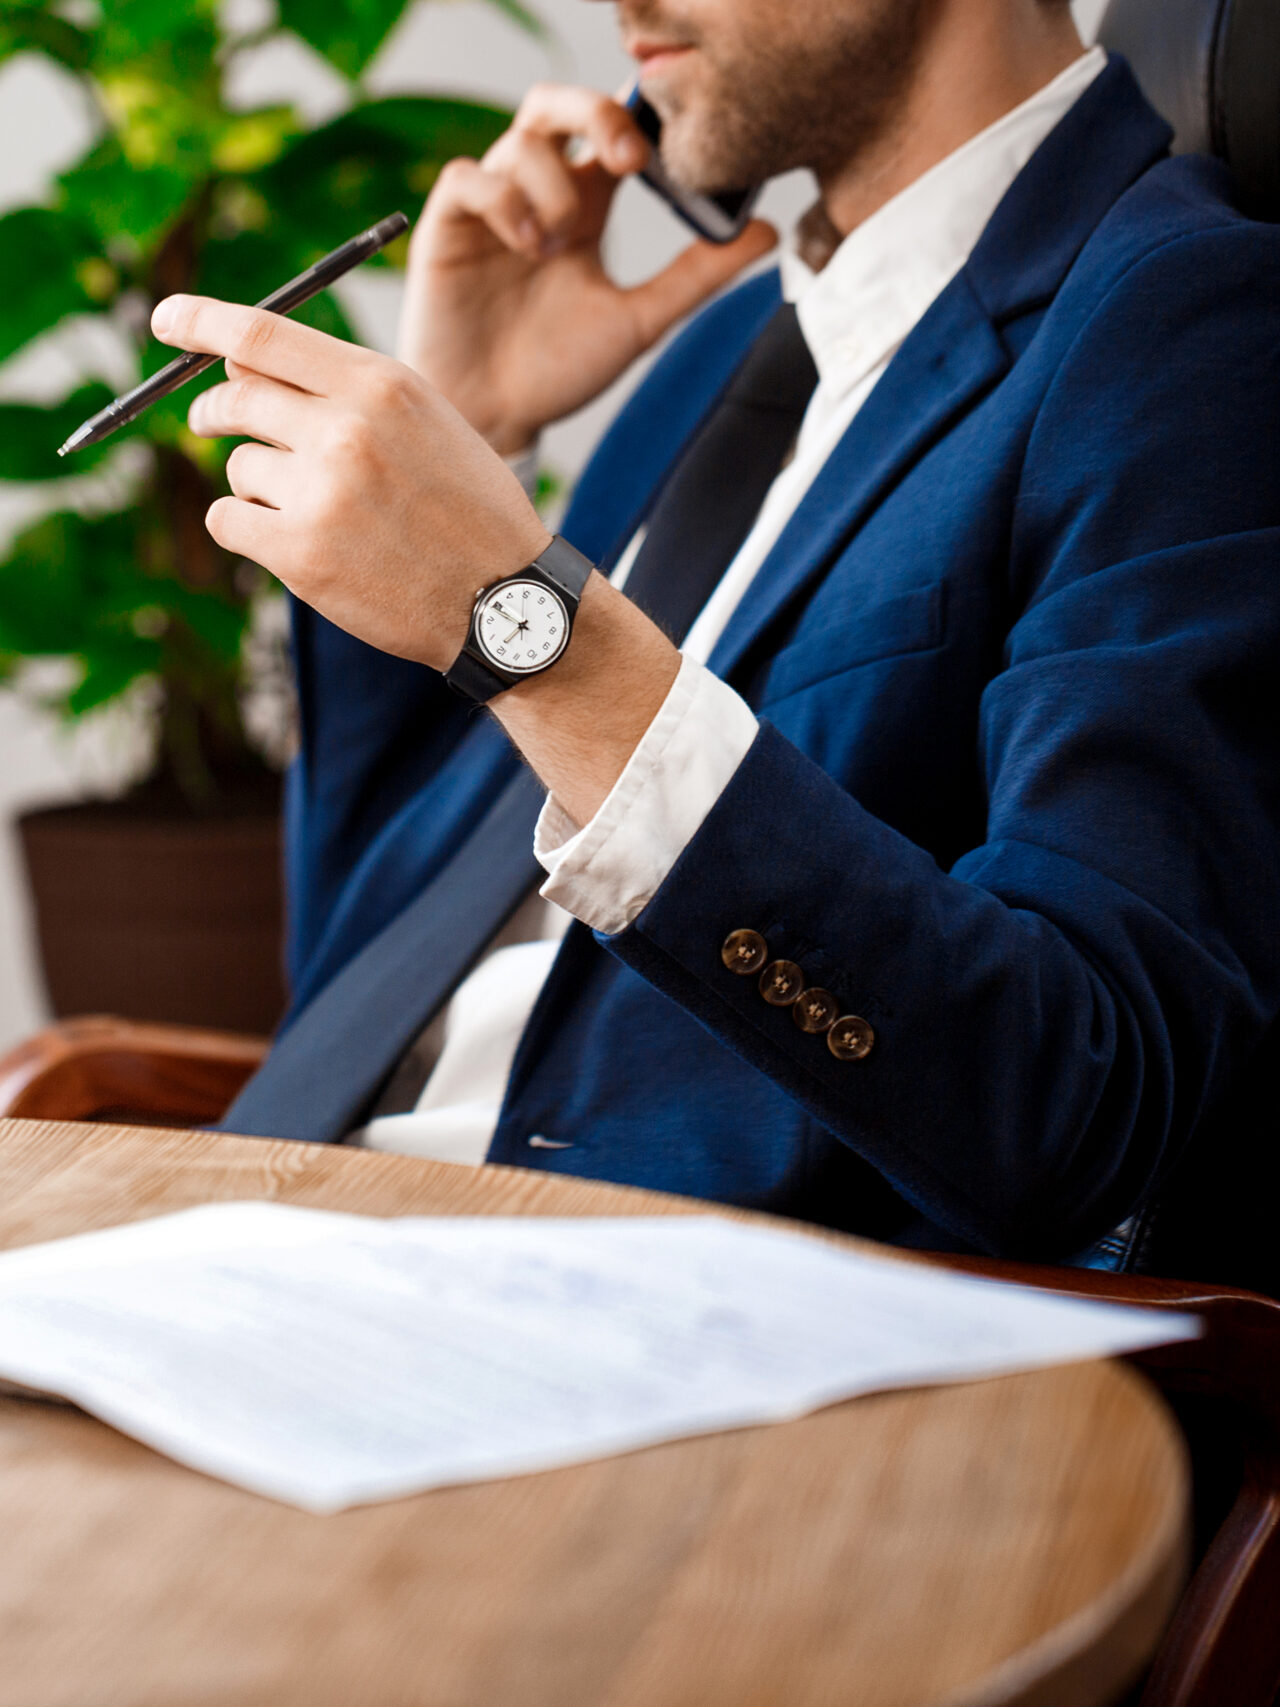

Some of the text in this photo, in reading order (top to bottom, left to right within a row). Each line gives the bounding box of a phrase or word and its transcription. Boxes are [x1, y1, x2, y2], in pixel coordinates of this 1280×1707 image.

[538, 597, 546, 605] 6
[547, 611, 554, 619] 7
[486, 616, 495, 624] 2
[549, 626, 556, 635] 8
[542, 642, 551, 650] 9
[496, 646, 506, 656] 12
[527, 649, 537, 660] 10
[513, 653, 520, 661] 11
